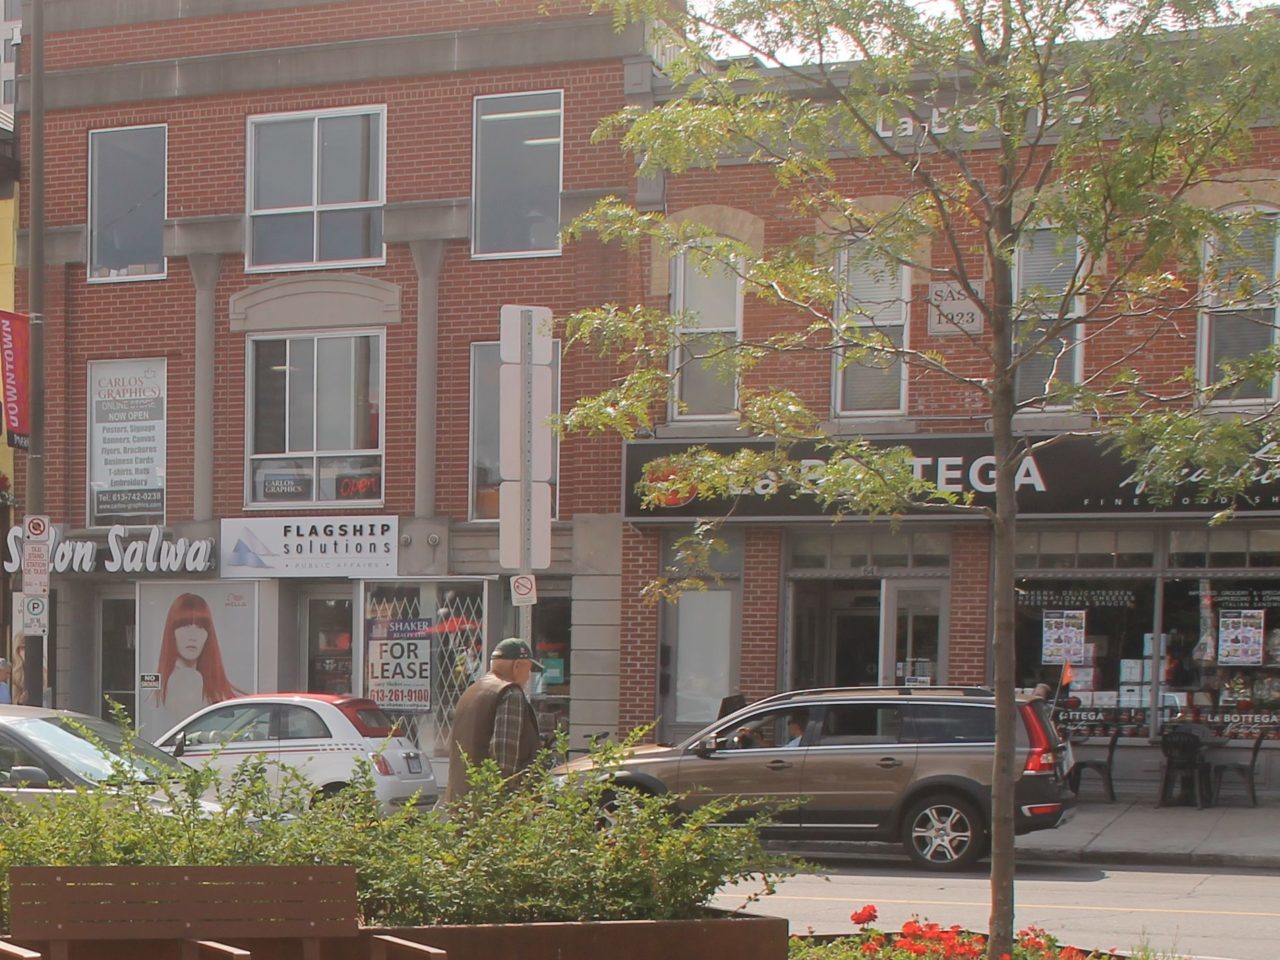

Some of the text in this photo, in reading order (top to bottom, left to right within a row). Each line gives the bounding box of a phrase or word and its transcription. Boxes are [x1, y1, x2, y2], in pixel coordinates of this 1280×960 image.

[936, 312, 975, 325] 1923
[2, 320, 19, 427] DOWNTOWN
[98, 376, 144, 388] CARLOS
[98, 386, 157, 398] GRAPHICS
[109, 411, 149, 420] NOW OPEN
[283, 524, 391, 537] FLAGSHIP
[104, 524, 212, 573] Salwa
[283, 540, 390, 554] solutions
[32, 603, 40, 611] P
[389, 621, 429, 631] SHAKER
[379, 642, 418, 660] FOR
[370, 662, 429, 679] LEASE
[1223, 714, 1279, 723] BOTTEGA
